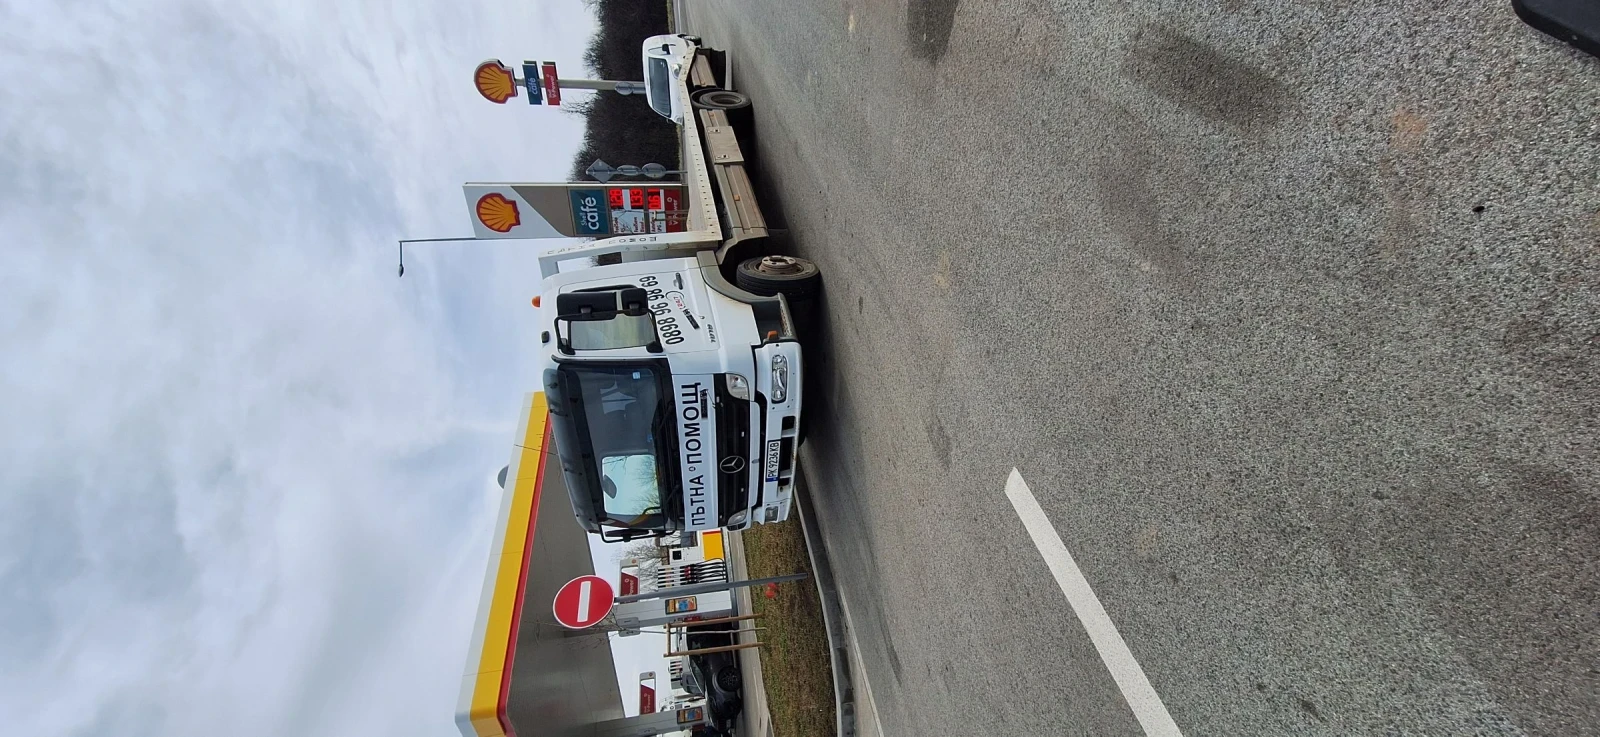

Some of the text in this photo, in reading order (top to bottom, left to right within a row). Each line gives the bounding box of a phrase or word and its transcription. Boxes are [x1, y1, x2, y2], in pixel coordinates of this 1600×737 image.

[528, 77, 538, 95] café
[579, 212, 588, 226] Shell
[580, 197, 600, 230] café
[639, 276, 684, 345] 0898 96 98 69
[681, 382, 706, 526] ПЪТНА ПОМОЩ
[768, 452, 778, 469] 9236
[767, 470, 777, 478] PK
